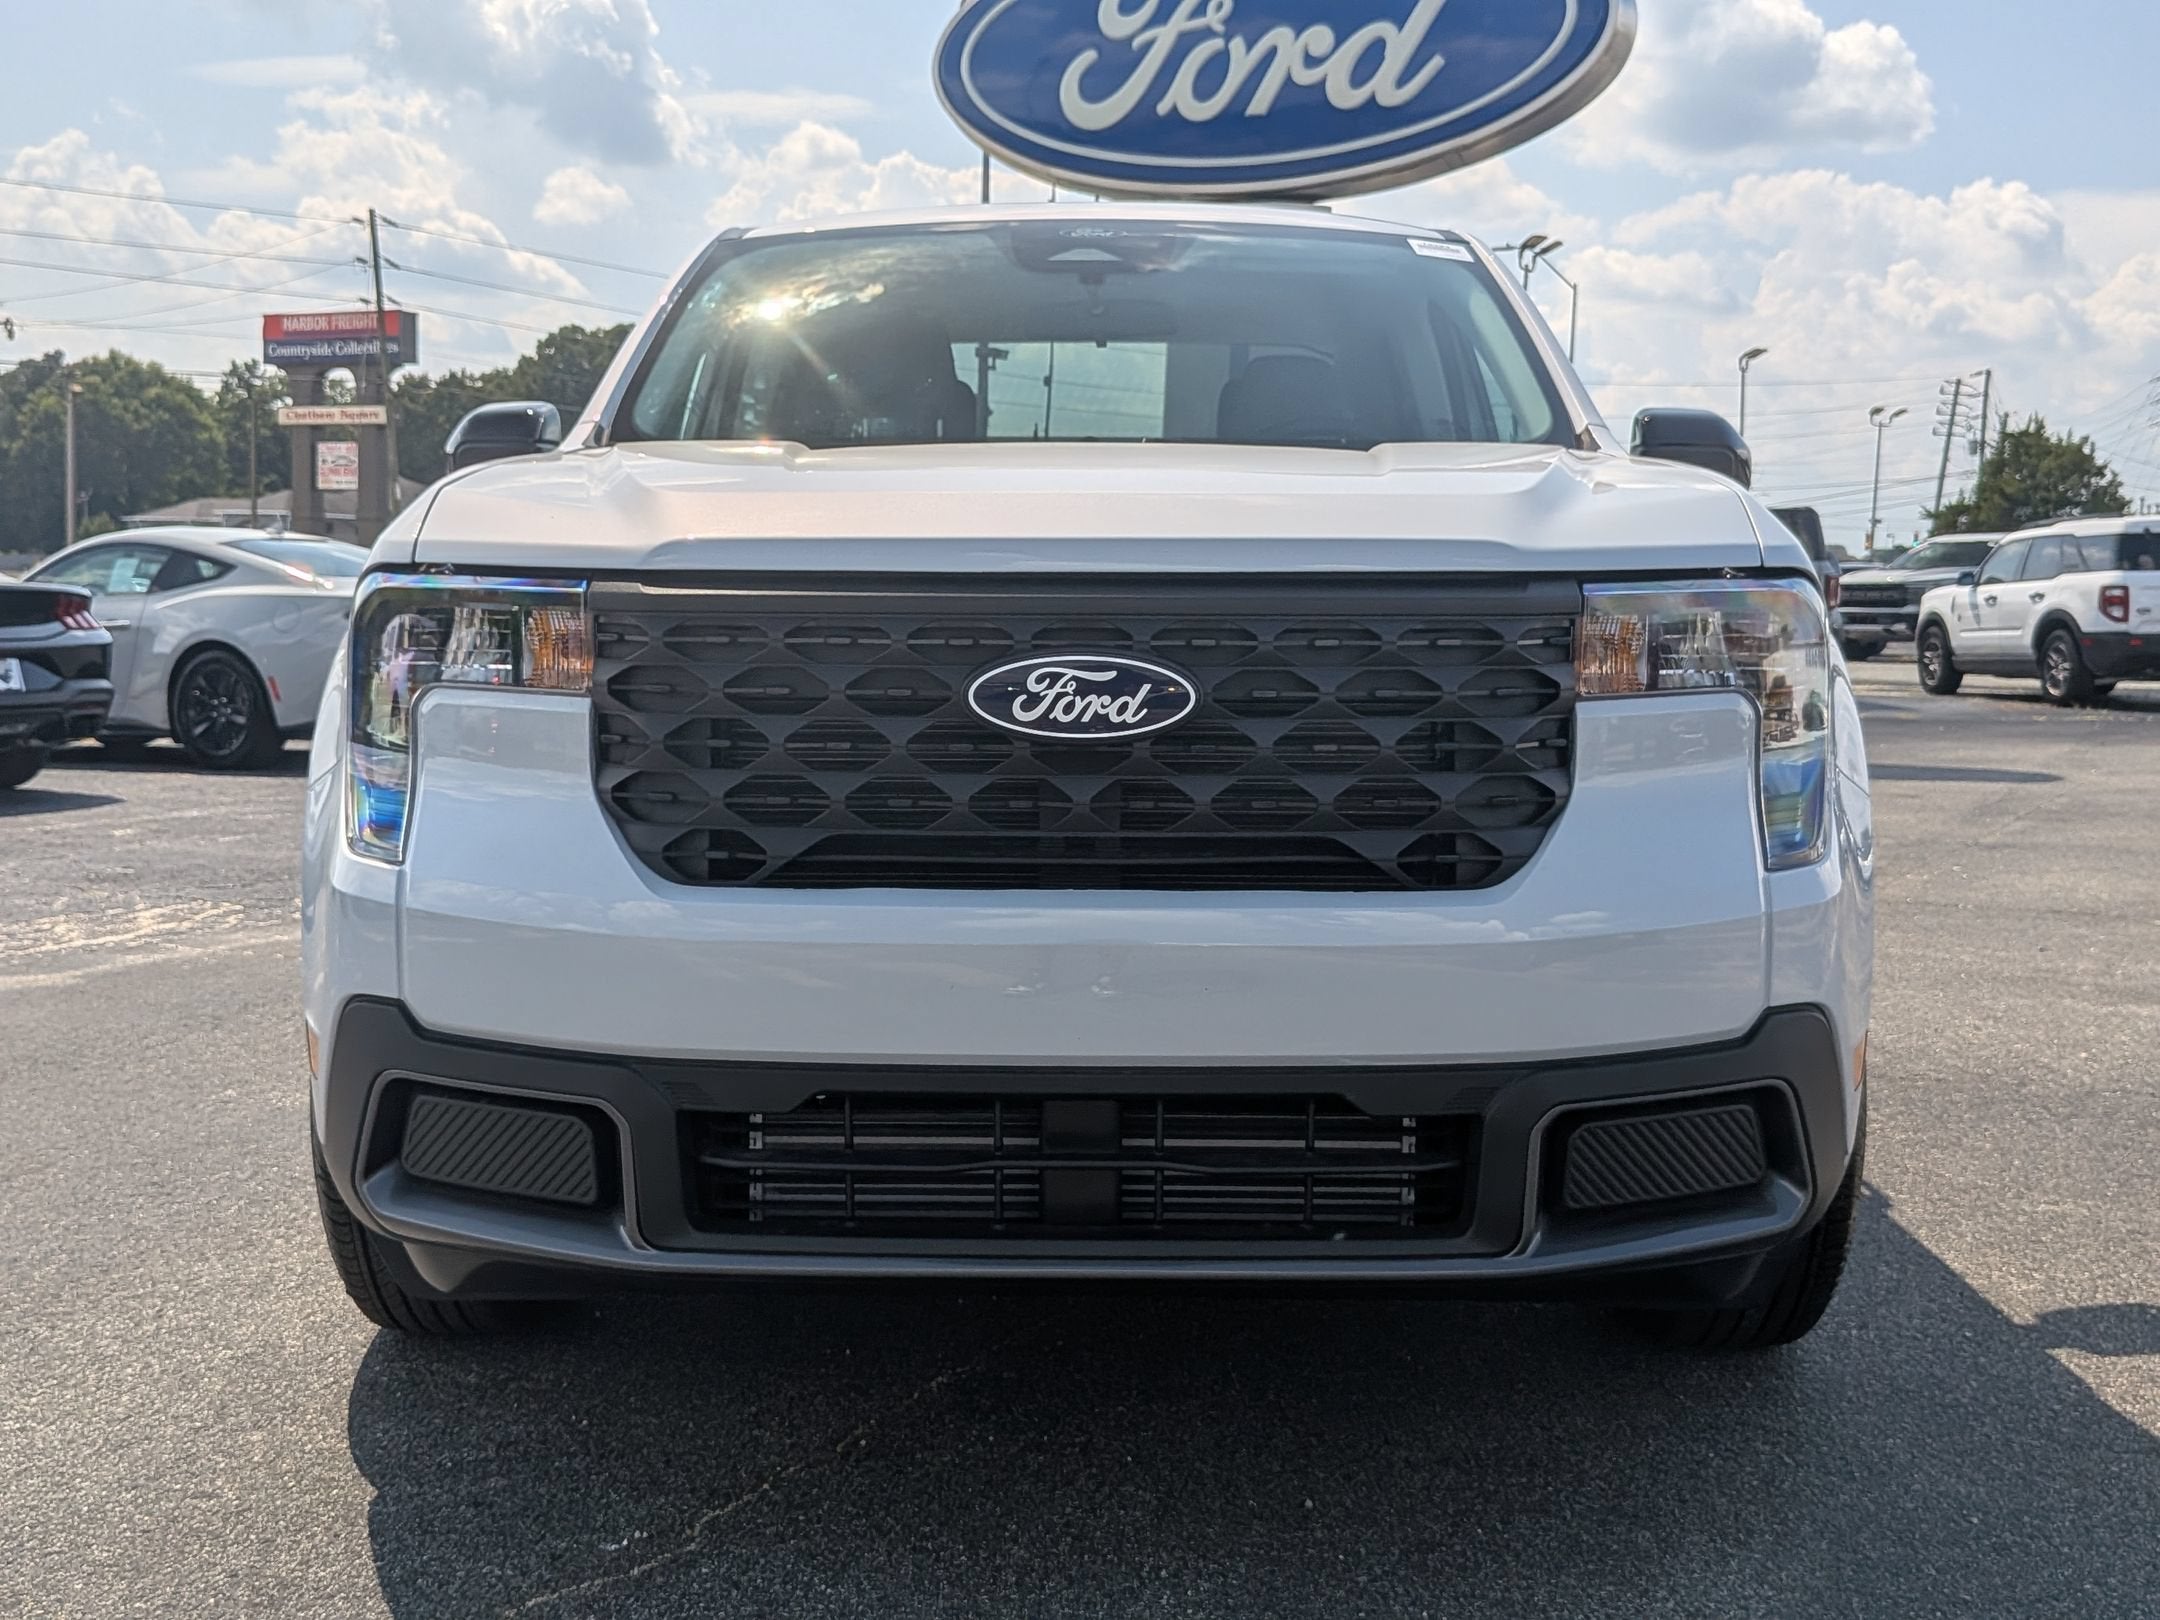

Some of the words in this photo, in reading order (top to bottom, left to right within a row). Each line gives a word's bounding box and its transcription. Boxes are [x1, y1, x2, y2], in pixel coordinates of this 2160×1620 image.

[1060, 0, 1446, 131] Ford
[283, 315, 329, 331] HARBOR
[331, 313, 378, 330] FREIGHT
[268, 342, 333, 360] Countryside
[1012, 667, 1153, 723] Ford
